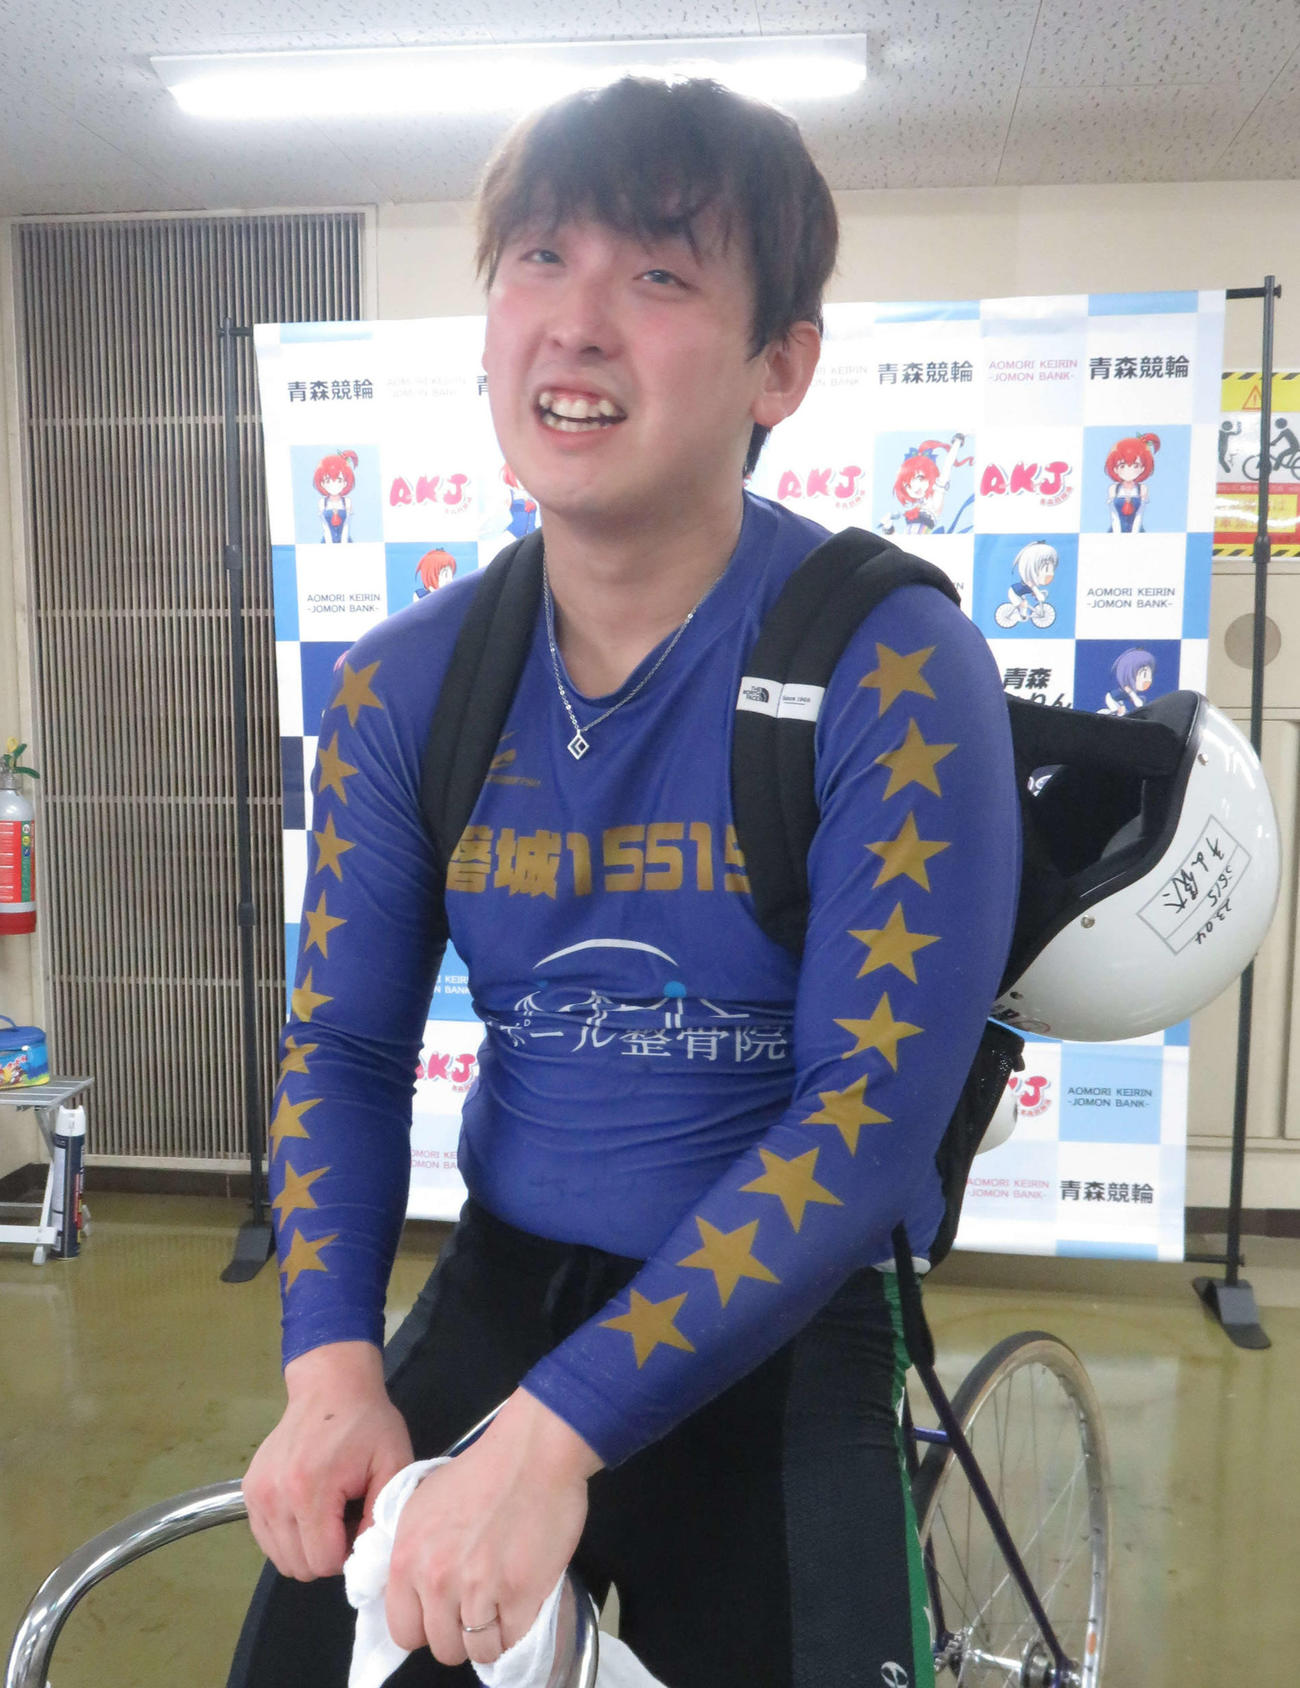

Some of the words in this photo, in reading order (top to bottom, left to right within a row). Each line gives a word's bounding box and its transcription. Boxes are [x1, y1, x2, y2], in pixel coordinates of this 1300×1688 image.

[989, 361, 1034, 370] AOMORI
[1040, 360, 1078, 369] KEIRIN
[1089, 355, 1190, 380] 青森競輪
[878, 361, 974, 384] 青森競輪
[287, 379, 374, 402] 青森競輪
[1087, 587, 1133, 597] AOMORI
[1137, 587, 1176, 597] KEIRIN
[307, 593, 346, 602] AOMORI
[349, 593, 381, 601] KEIRIN
[1003, 668, 1052, 690] 青森
[1068, 1087, 1111, 1096] AOMORI
[1116, 1088, 1152, 1097] KEIRIN
[411, 1150, 440, 1158] OMORI
[967, 1178, 1009, 1187] AOMORI
[1014, 1179, 1049, 1188] KEIRIN
[1060, 1180, 1154, 1204] 青森競輪
